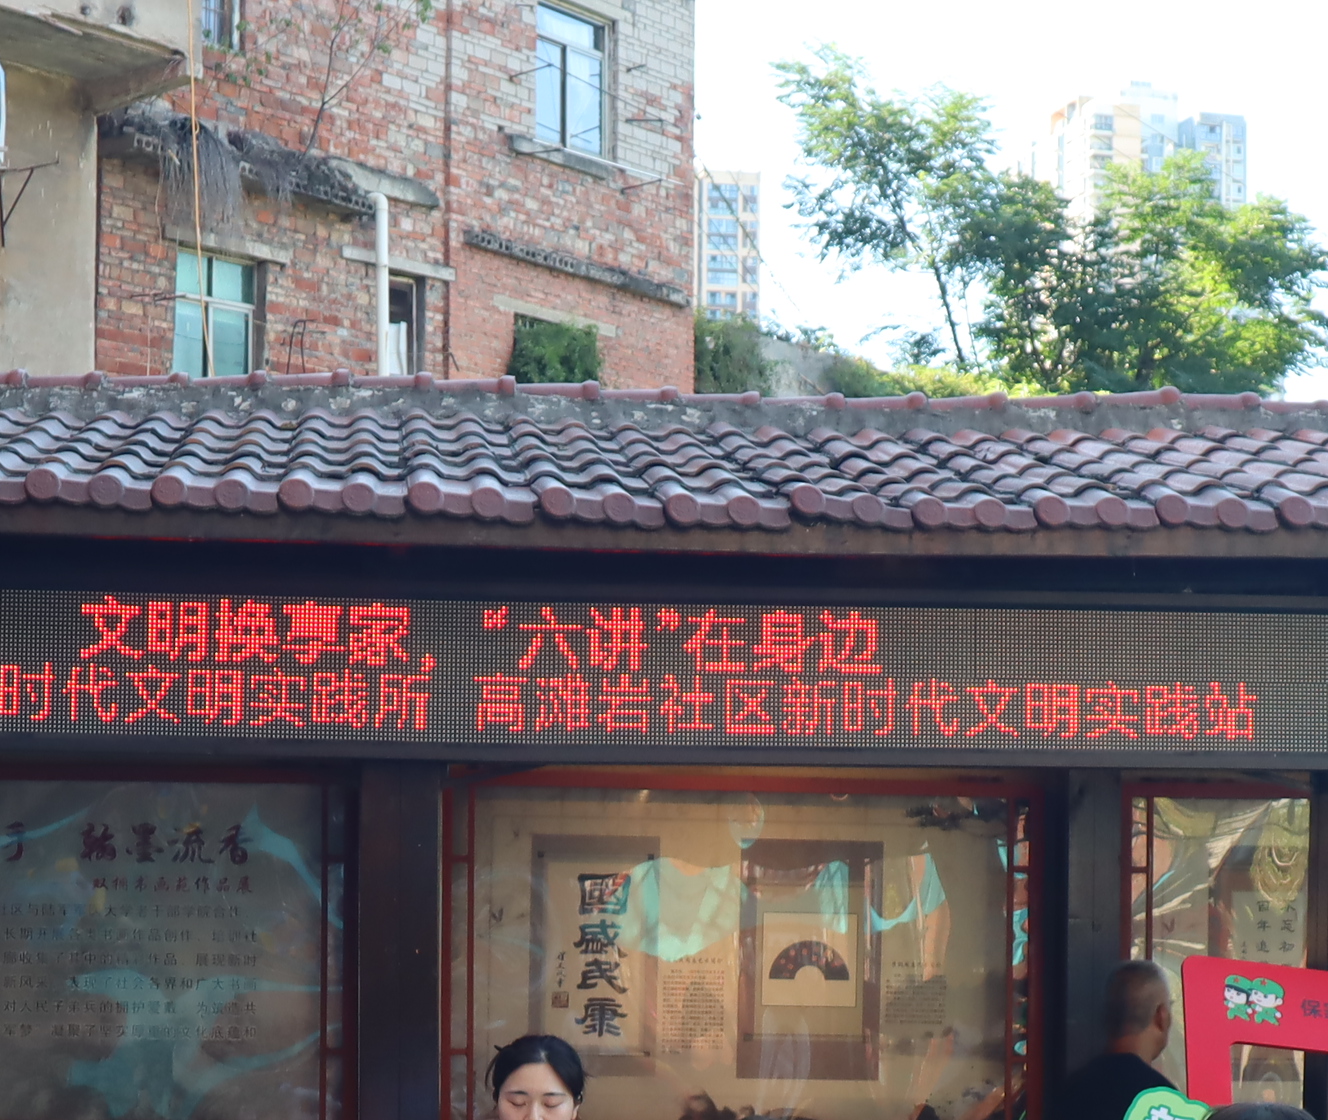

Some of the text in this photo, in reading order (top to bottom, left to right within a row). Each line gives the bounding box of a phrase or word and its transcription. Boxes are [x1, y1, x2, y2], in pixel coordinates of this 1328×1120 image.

[472, 673, 1258, 743] 高滩岩社区新时代文明实践站
